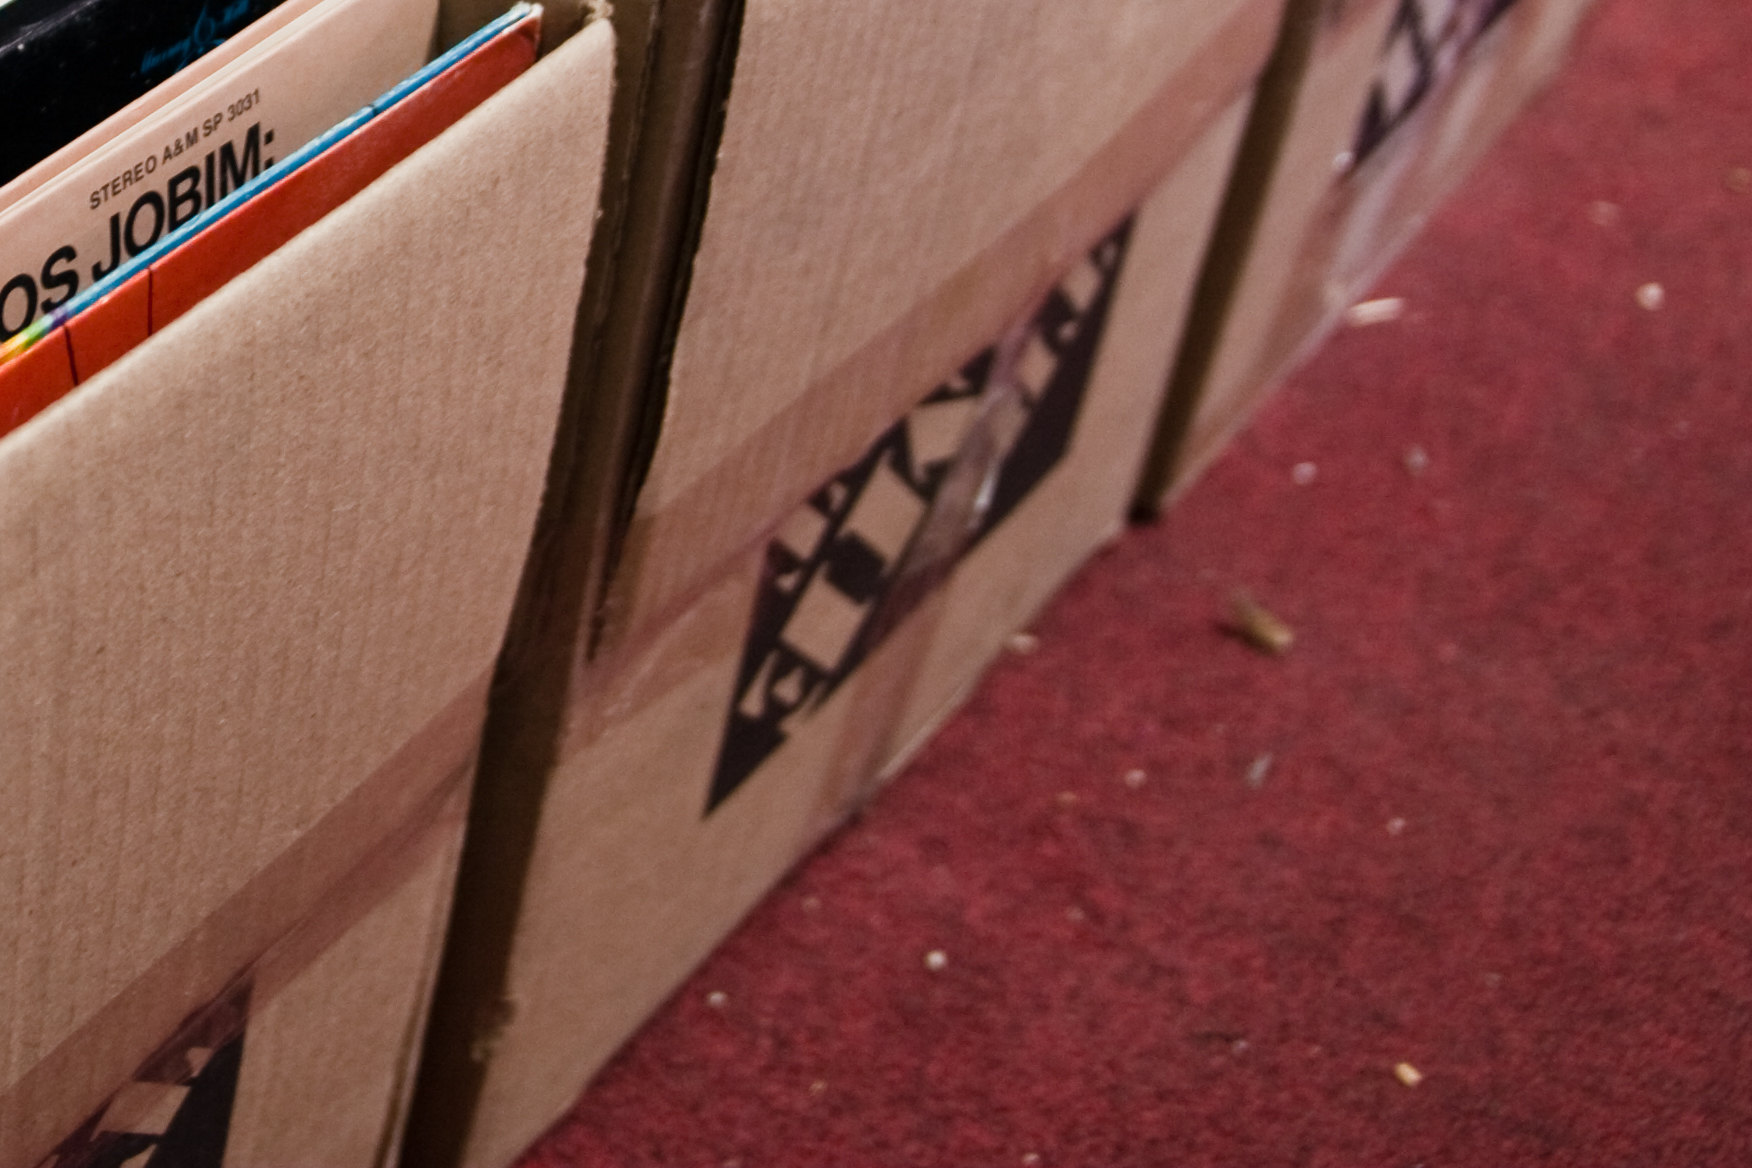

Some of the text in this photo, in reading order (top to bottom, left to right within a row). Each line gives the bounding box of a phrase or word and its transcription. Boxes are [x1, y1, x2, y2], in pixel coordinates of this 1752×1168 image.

[89, 88, 261, 210] STEREO A&M SP 3031
